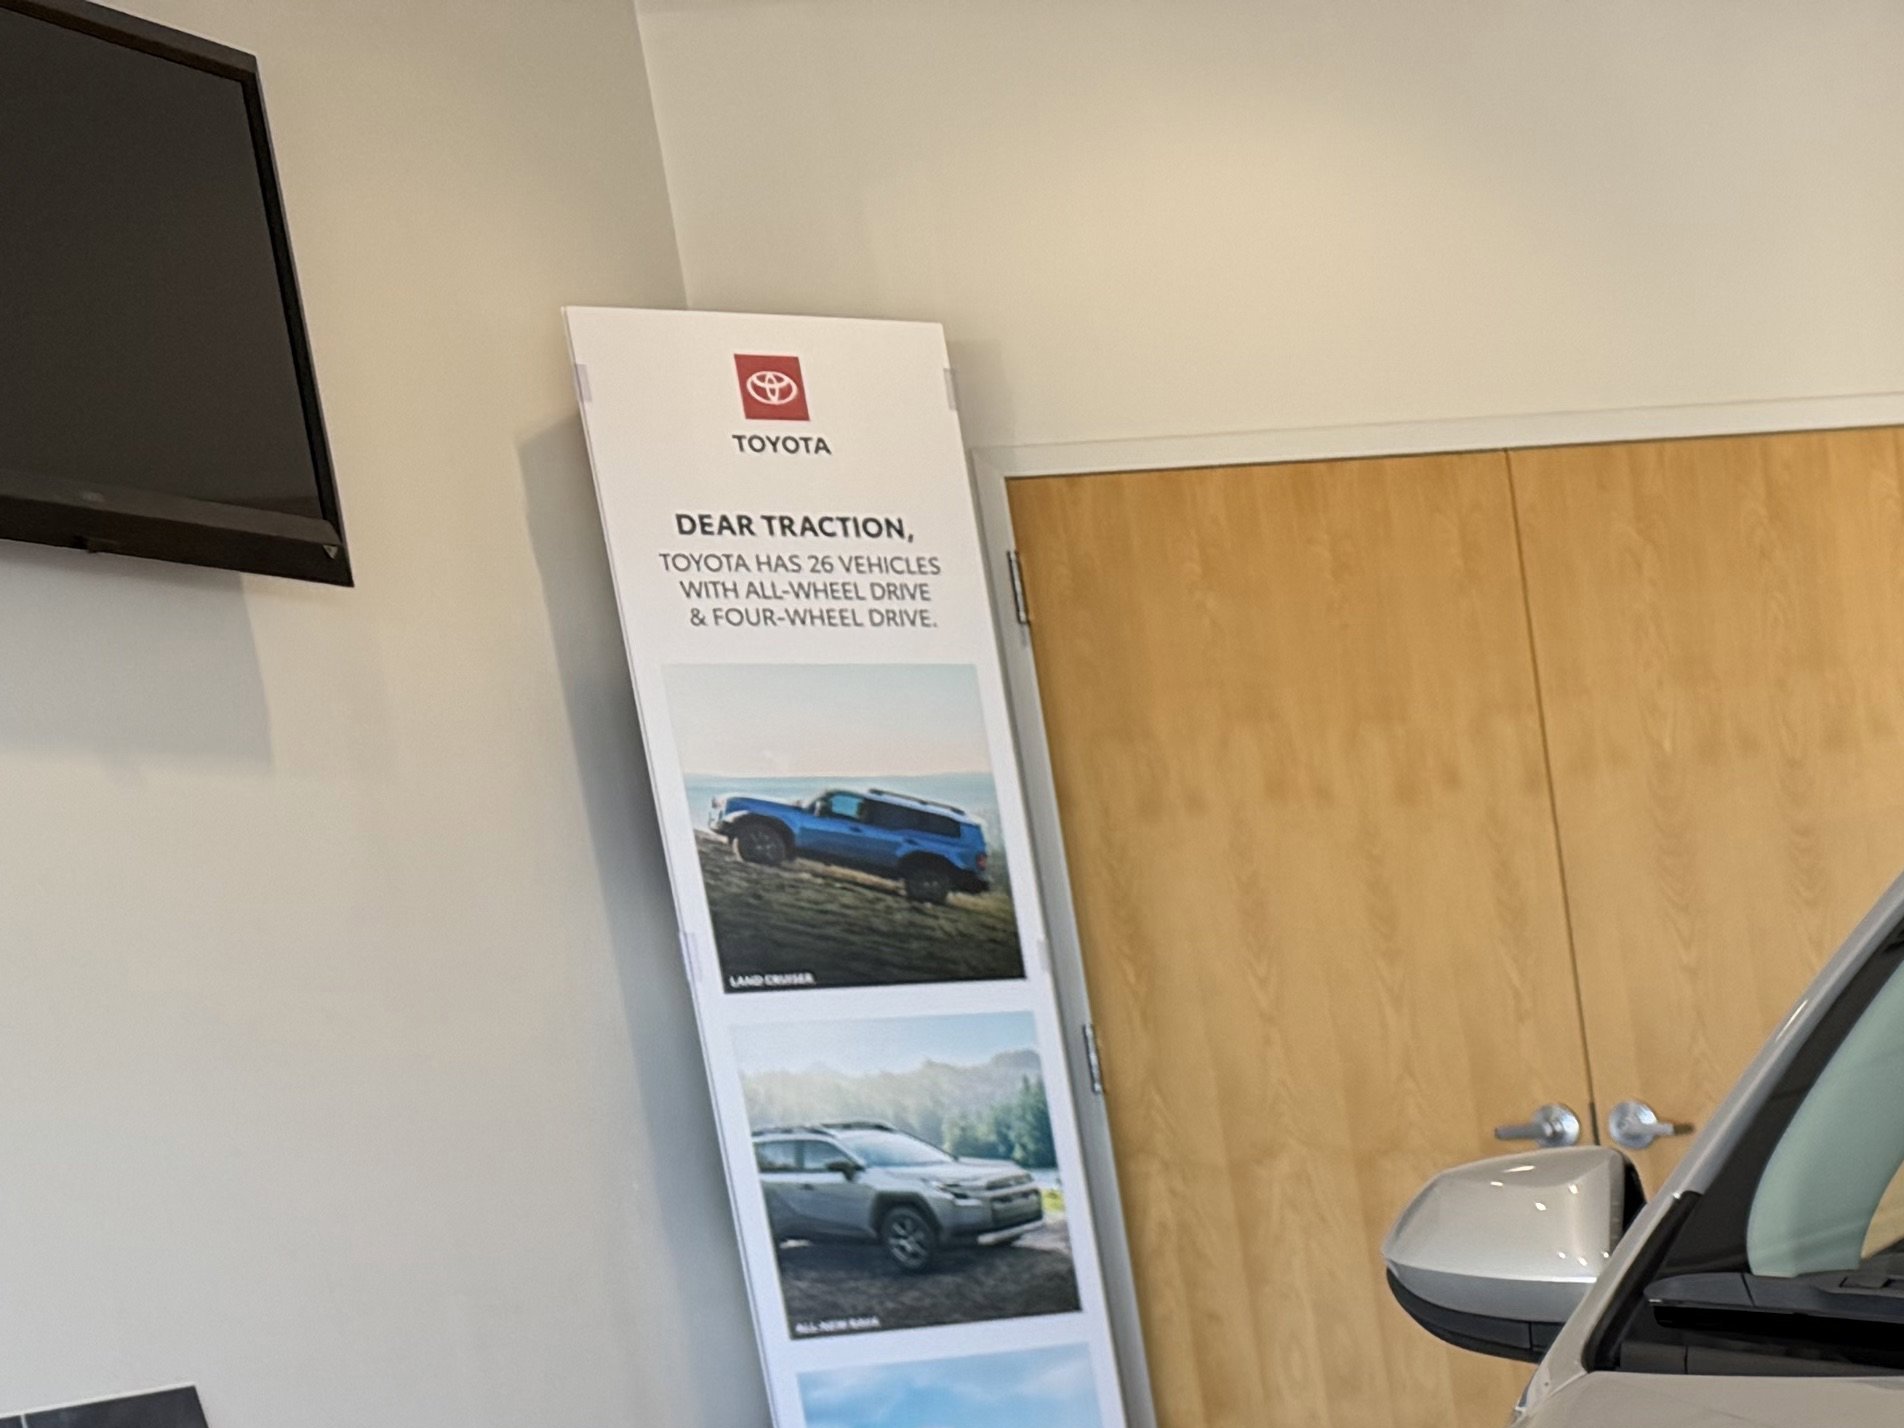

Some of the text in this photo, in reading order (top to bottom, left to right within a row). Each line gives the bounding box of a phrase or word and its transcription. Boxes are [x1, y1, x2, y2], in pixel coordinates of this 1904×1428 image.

[732, 434, 832, 455] TOYOTA
[675, 513, 914, 543] DEAR TRACTION,
[659, 553, 941, 575] TOYOTA HAS 26 VEHICLES
[679, 580, 932, 601] WITH ALL-WHEEL DRIVE
[690, 608, 938, 627] & FOUR-WHEEL DRIVE.
